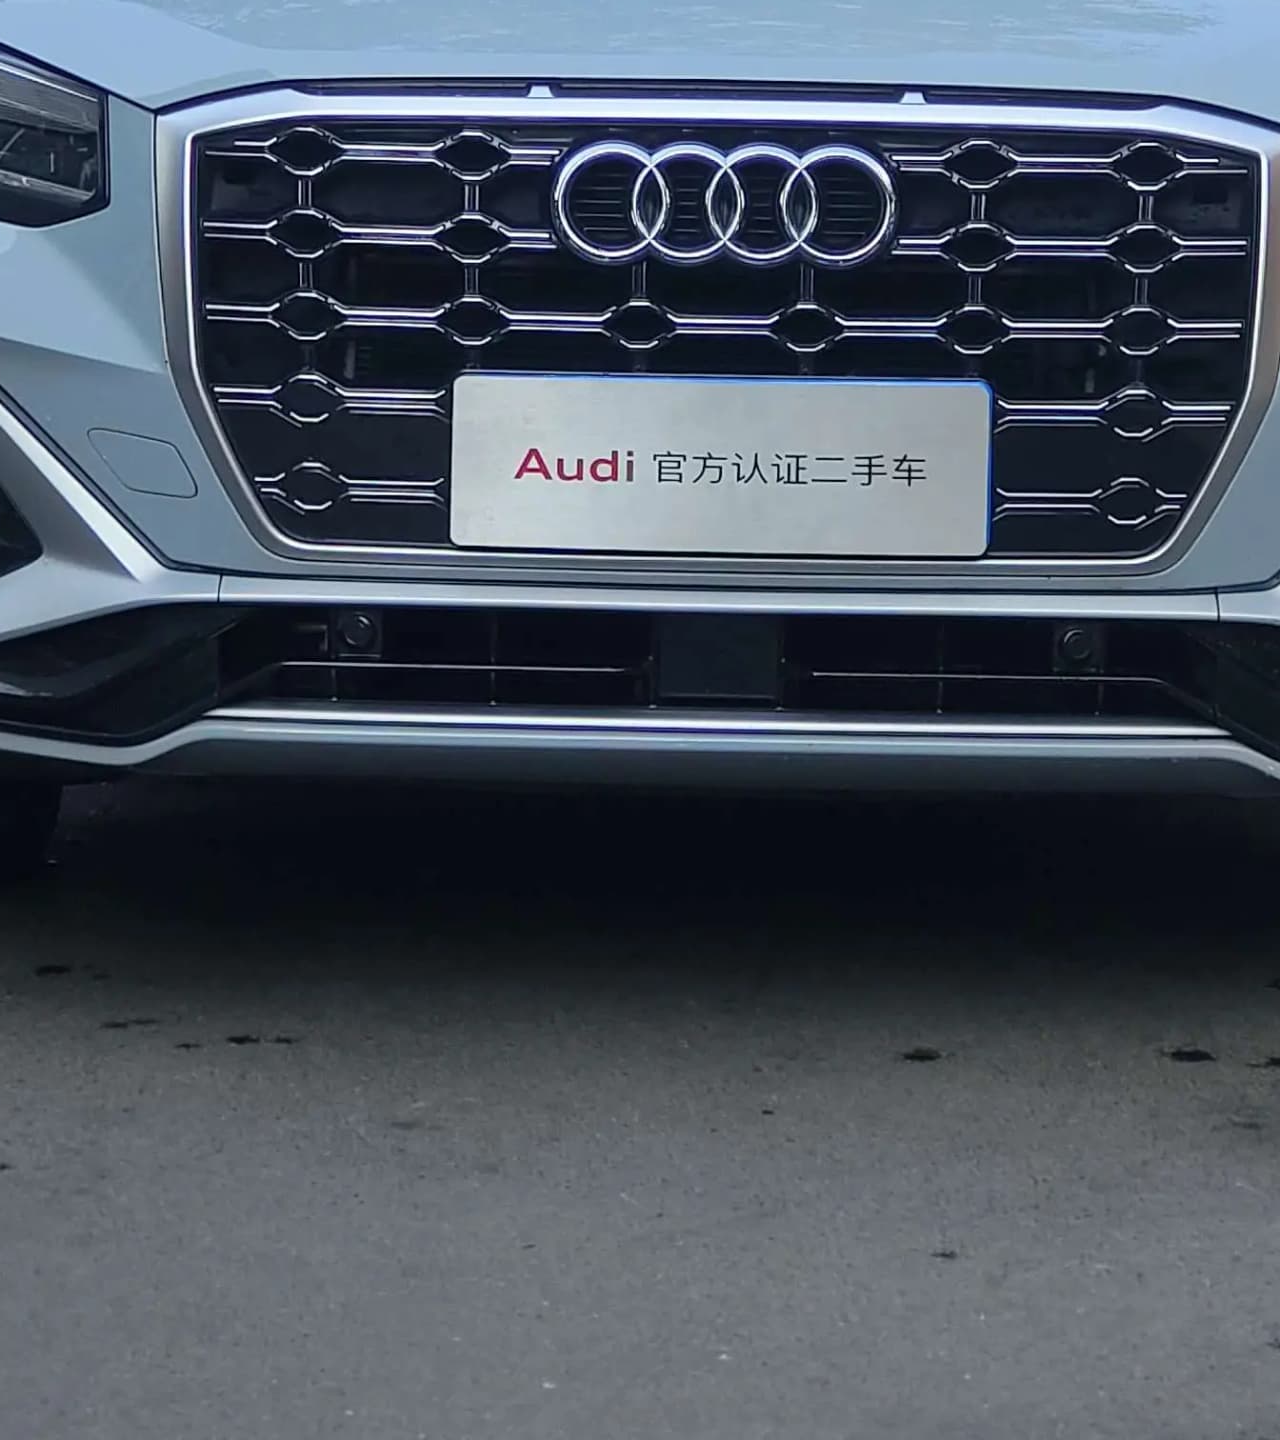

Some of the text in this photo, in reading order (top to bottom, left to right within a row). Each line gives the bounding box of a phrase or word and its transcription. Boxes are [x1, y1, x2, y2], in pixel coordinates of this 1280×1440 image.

[514, 447, 927, 487] Audi 官方认证二手车
